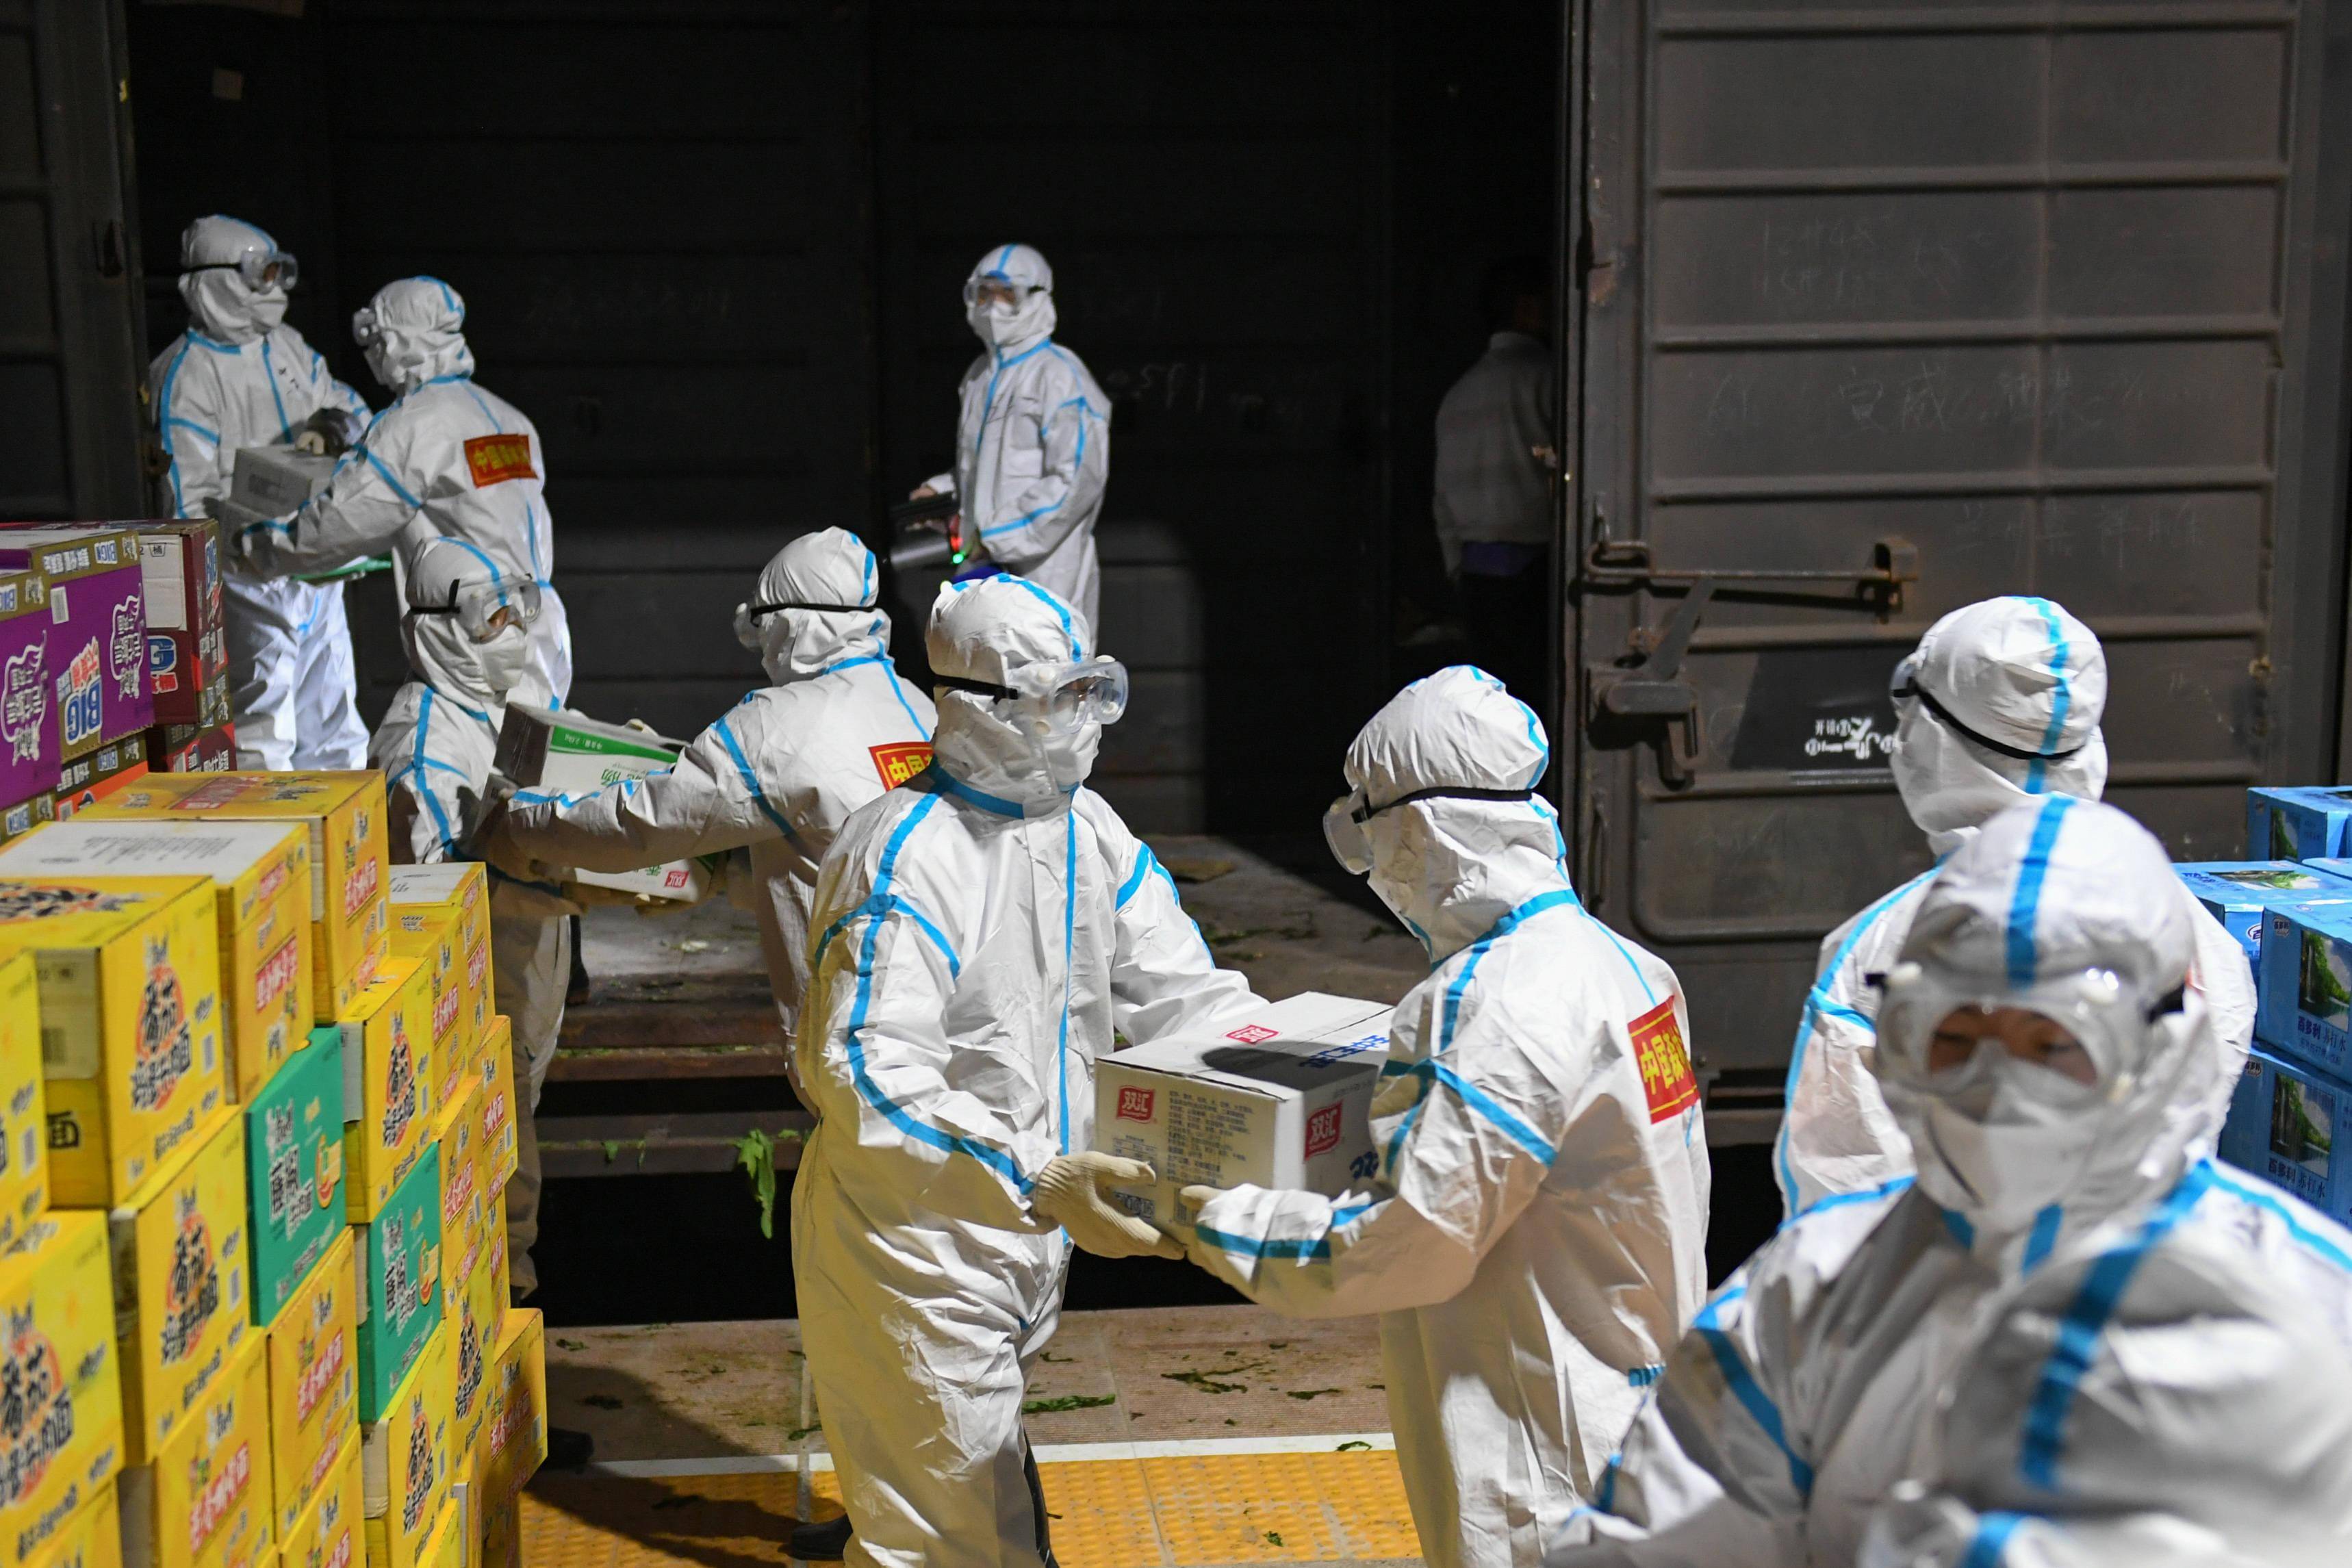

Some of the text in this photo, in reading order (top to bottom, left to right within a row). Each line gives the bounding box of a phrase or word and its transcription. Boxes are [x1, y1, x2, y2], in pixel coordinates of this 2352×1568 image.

[67, 683, 101, 743] BIG
[2298, 1016, 2321, 1041] 百多利
[1122, 1091, 1149, 1112] 双汇
[1310, 1110, 1337, 1144] 双汇
